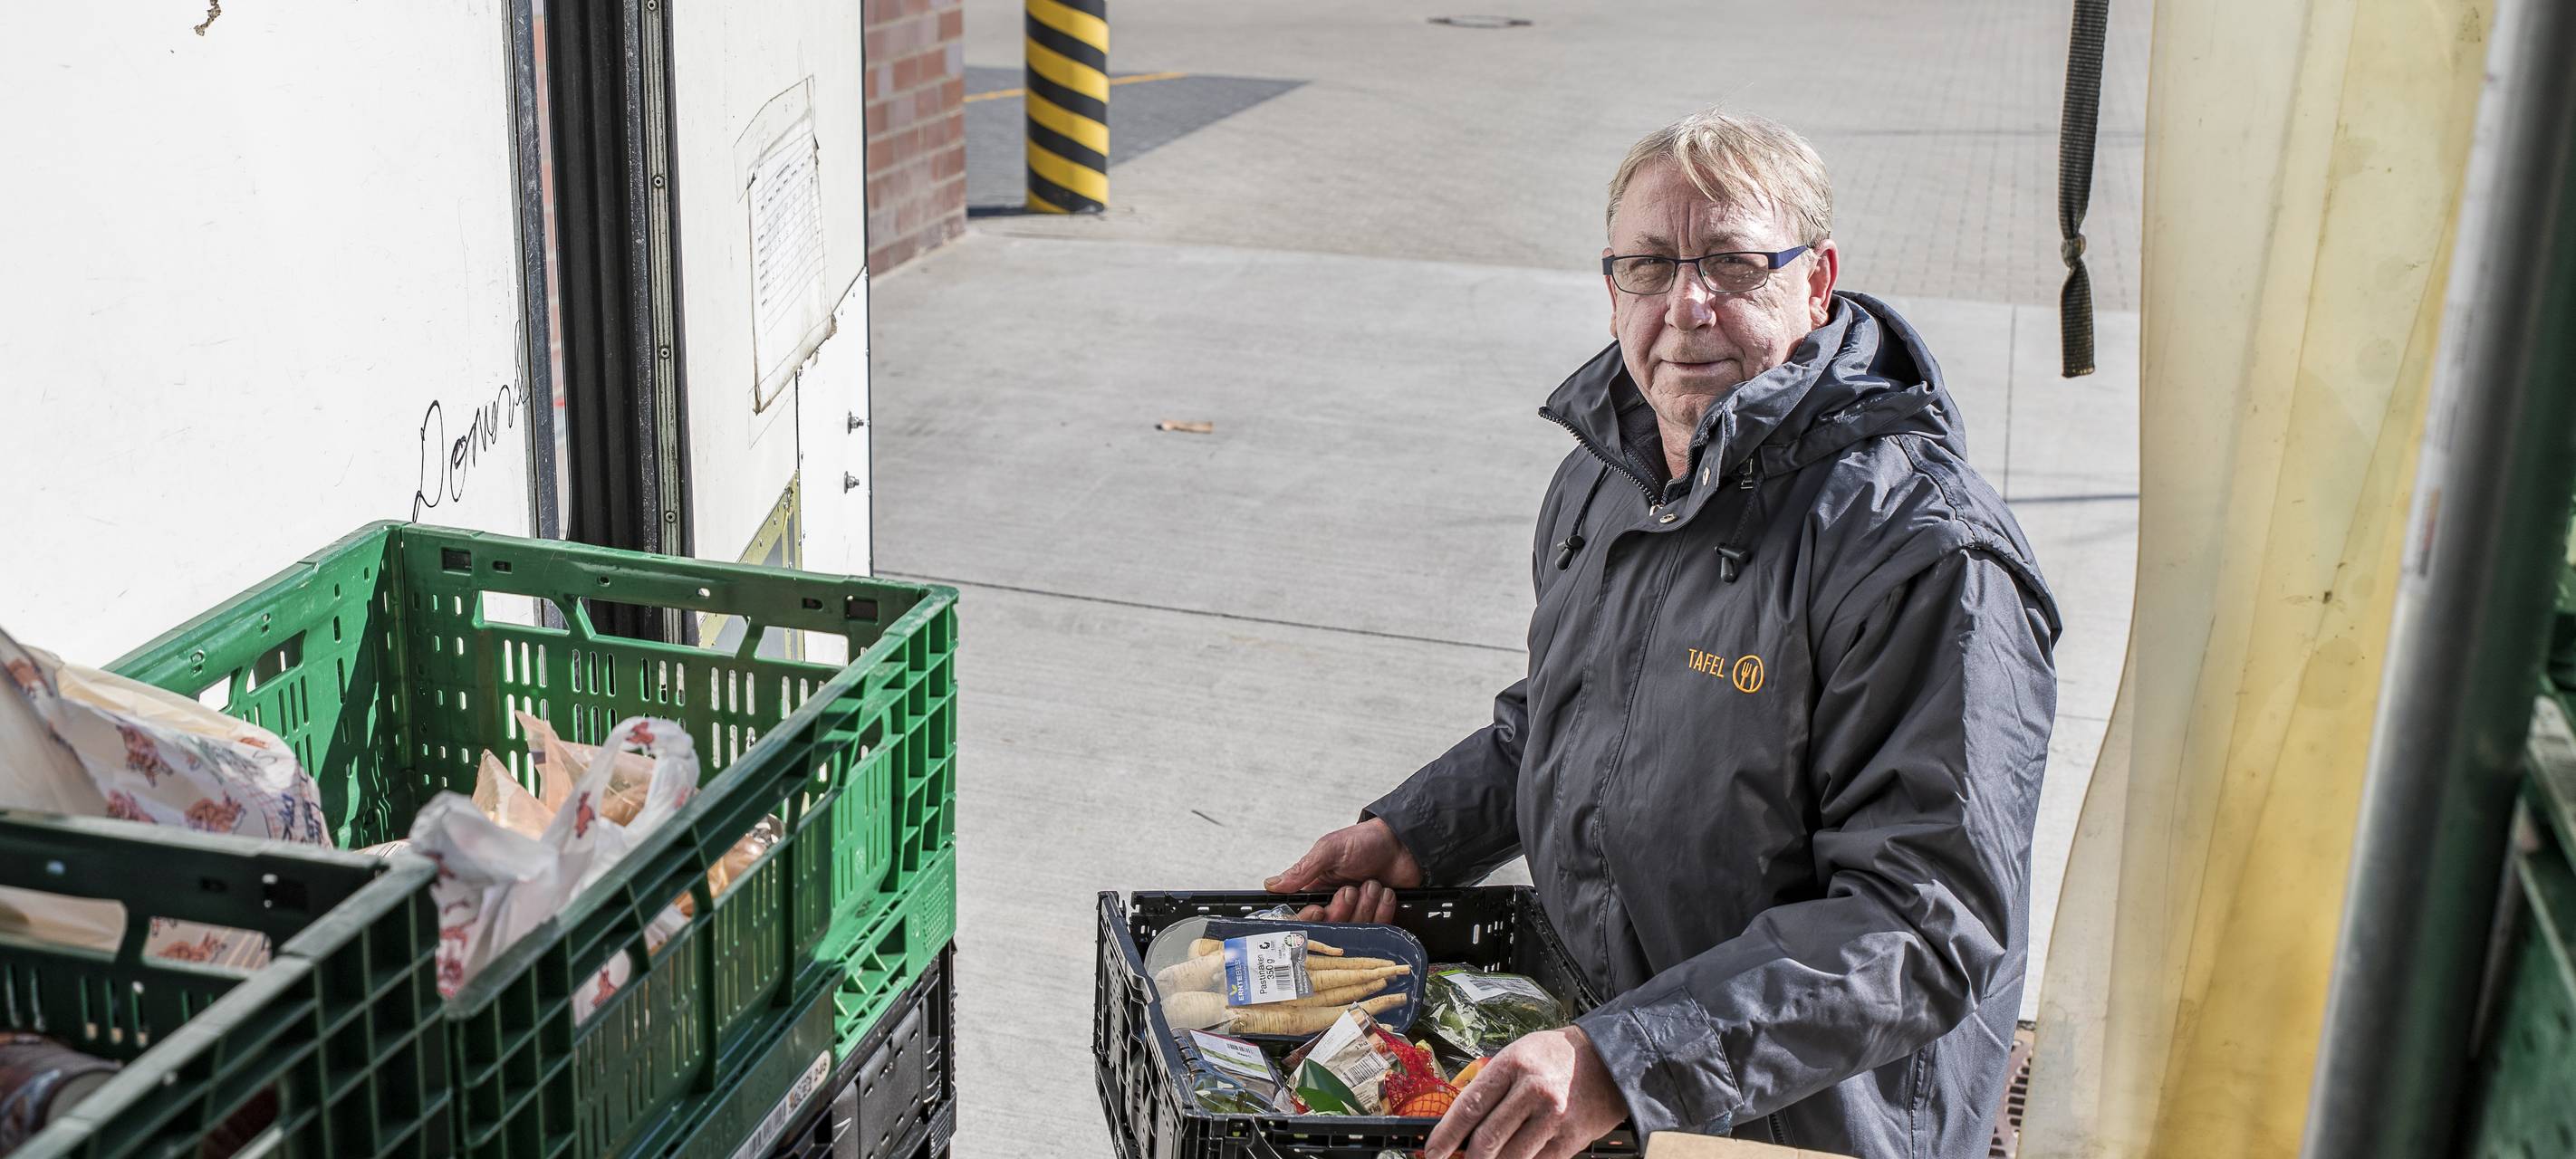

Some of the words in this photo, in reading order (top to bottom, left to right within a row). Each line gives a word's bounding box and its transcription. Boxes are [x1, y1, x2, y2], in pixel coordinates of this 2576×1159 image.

[1688, 647, 1725, 678] TAFEL
[1235, 958, 1245, 1001] ERNTEBES
[1257, 953, 1268, 995] Pastinaken
[1266, 965, 1275, 980] 350
[1371, 1104, 1381, 1113] kg
